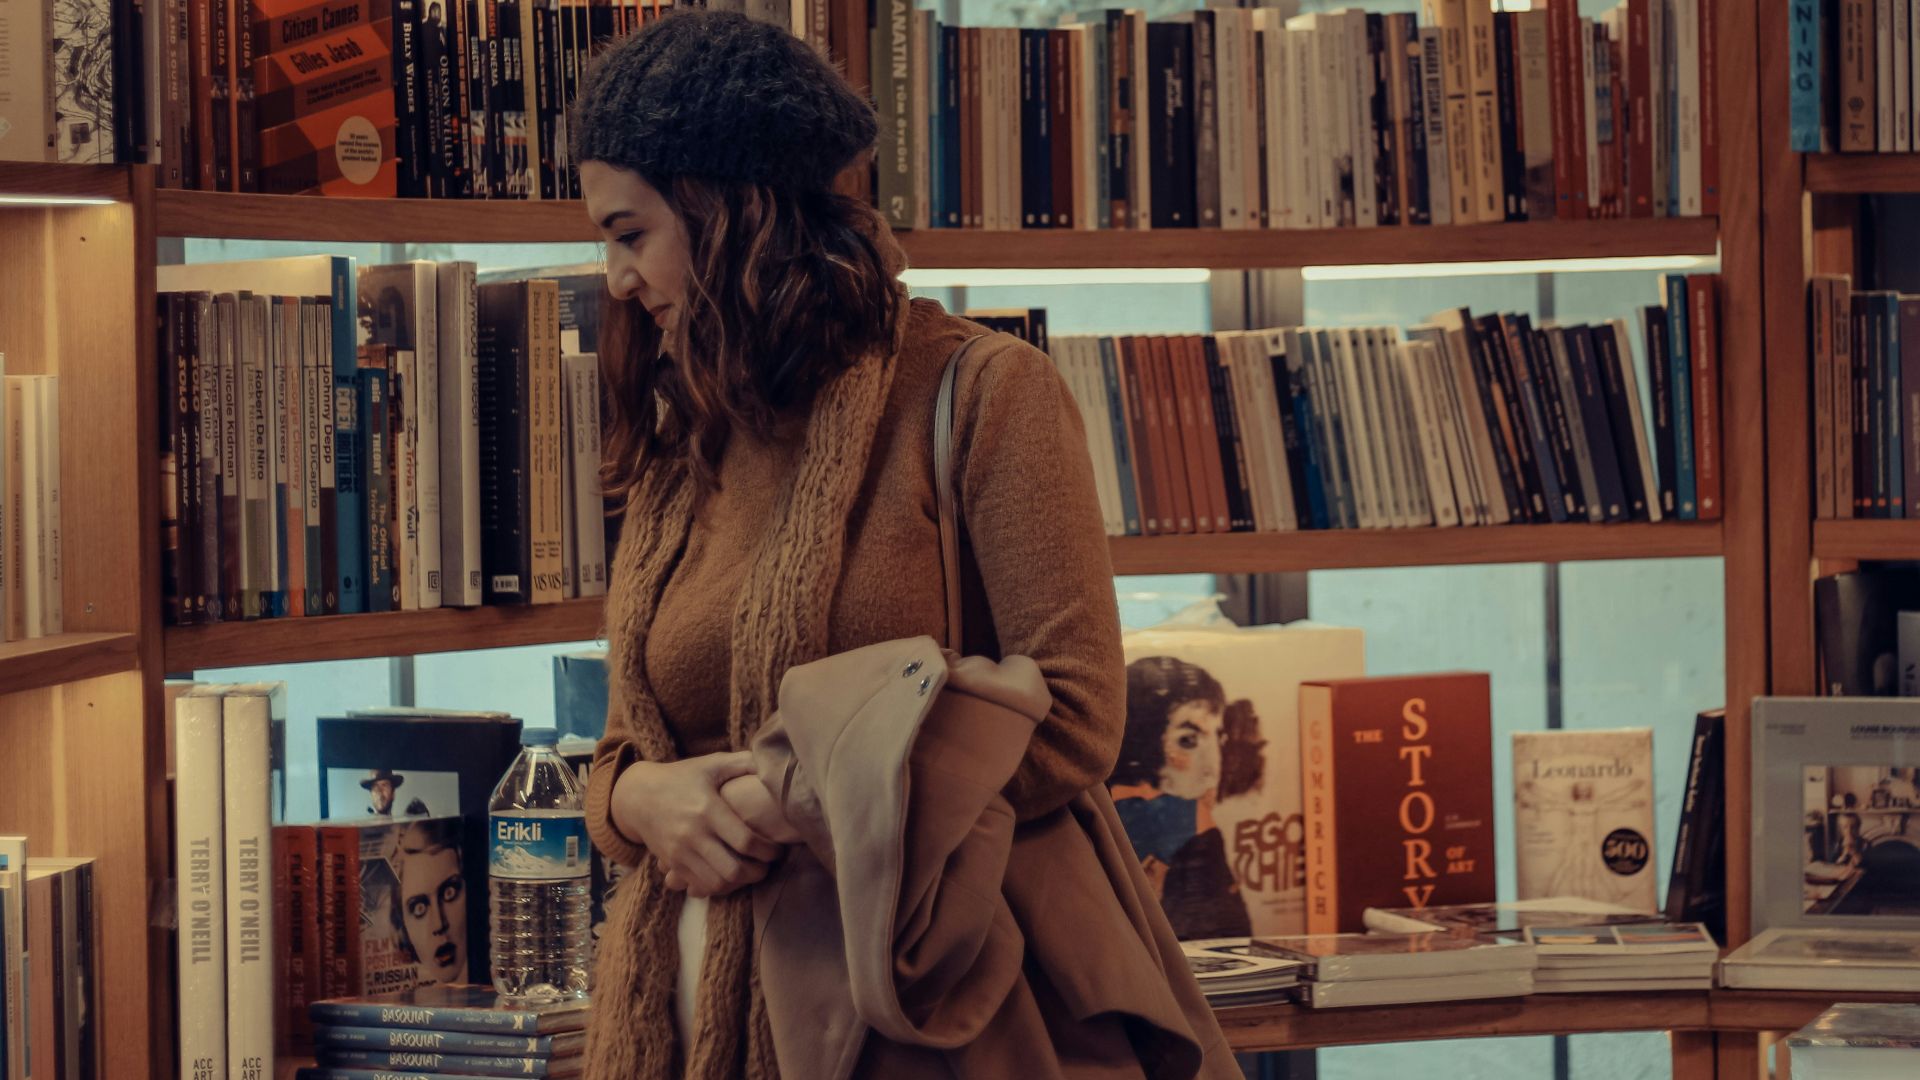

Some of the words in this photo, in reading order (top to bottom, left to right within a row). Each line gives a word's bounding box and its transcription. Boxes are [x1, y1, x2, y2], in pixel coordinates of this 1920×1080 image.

[170, 14, 178, 45] AND
[282, 16, 318, 44] Citizen
[321, 3, 360, 32] Cannes
[401, 22, 414, 59] BILLY
[217, 29, 226, 67] CUBA
[243, 31, 252, 70] CUBA
[289, 50, 330, 74] Gilles
[326, 37, 364, 64] Jacob
[489, 39, 499, 88] CINEMA
[1795, 0, 1814, 91] NING
[169, 50, 178, 102] SOUND
[403, 62, 416, 114] WILDER
[427, 69, 435, 106] SIMON
[439, 55, 451, 107] ORSON
[443, 114, 455, 168] WELLES
[534, 291, 542, 340] Behind
[547, 291, 556, 340] Behind
[203, 369, 213, 382] Al
[534, 345, 542, 370] the
[548, 345, 556, 370] the
[177, 354, 188, 414] SOLO
[191, 354, 200, 413] SOLO
[225, 368, 235, 417] Nicole
[248, 367, 256, 400] Jack
[255, 369, 264, 421] Robert
[278, 369, 286, 410] Meryl
[290, 369, 300, 425] George
[322, 367, 332, 421] Johnny
[534, 375, 542, 427] Camera
[548, 375, 557, 427] Camera
[575, 370, 585, 425] Hollywood
[588, 369, 598, 425] Hollywood
[203, 389, 214, 440] Pacino
[308, 369, 318, 440] Leonardo
[336, 386, 350, 431] COEN
[226, 420, 236, 479] Kidman
[248, 404, 257, 481] Nicholson
[256, 424, 265, 446] De
[279, 414, 287, 465] Streep
[322, 423, 333, 464] Depp
[371, 432, 382, 476] THEORY
[577, 427, 585, 454] Cats
[589, 425, 599, 453] Cats
[257, 449, 266, 481] Niro
[292, 429, 302, 490] Clooney
[309, 443, 320, 510] DiCaprio
[336, 432, 352, 494] BROTHERS
[406, 447, 415, 487] Trivia
[182, 467, 190, 508] WARS
[370, 487, 379, 521] Trivia
[379, 503, 388, 525] The
[407, 505, 417, 541] Vault
[370, 523, 379, 551] Quiz
[380, 526, 390, 571] Official
[371, 554, 381, 585] Book
[1352, 728, 1384, 744] THE
[1531, 757, 1634, 780] Leonardo
[1309, 720, 1328, 916] GOMBRICH
[1399, 697, 1437, 911] STORY
[497, 820, 543, 842] Erikli
[1235, 812, 1305, 852] EGO
[1604, 839, 1647, 859] 500
[190, 837, 210, 895] TERRY
[239, 836, 260, 894] TERRY
[290, 853, 303, 887] FILM
[334, 853, 347, 887] FILM
[1445, 845, 1466, 860] OF
[1446, 859, 1476, 874] ART
[322, 852, 334, 915] RUSSIAN
[191, 899, 212, 965] O'NEILL
[239, 898, 260, 964] O'NEILL
[365, 937, 390, 953] FILM
[291, 957, 304, 977] OF
[324, 919, 336, 1000] AVANT-GA
[335, 958, 347, 977] OF
[374, 966, 419, 985] RUSSIAN
[335, 982, 347, 999] TH
[381, 1008, 435, 1025] BASQUIAT
[389, 1031, 445, 1049] BASQUIAT
[192, 1057, 214, 1070] ACC
[193, 1070, 214, 1080] ART
[241, 1056, 262, 1069] ACC
[242, 1069, 262, 1080] ART
[389, 1053, 444, 1069] BASQUIAT
